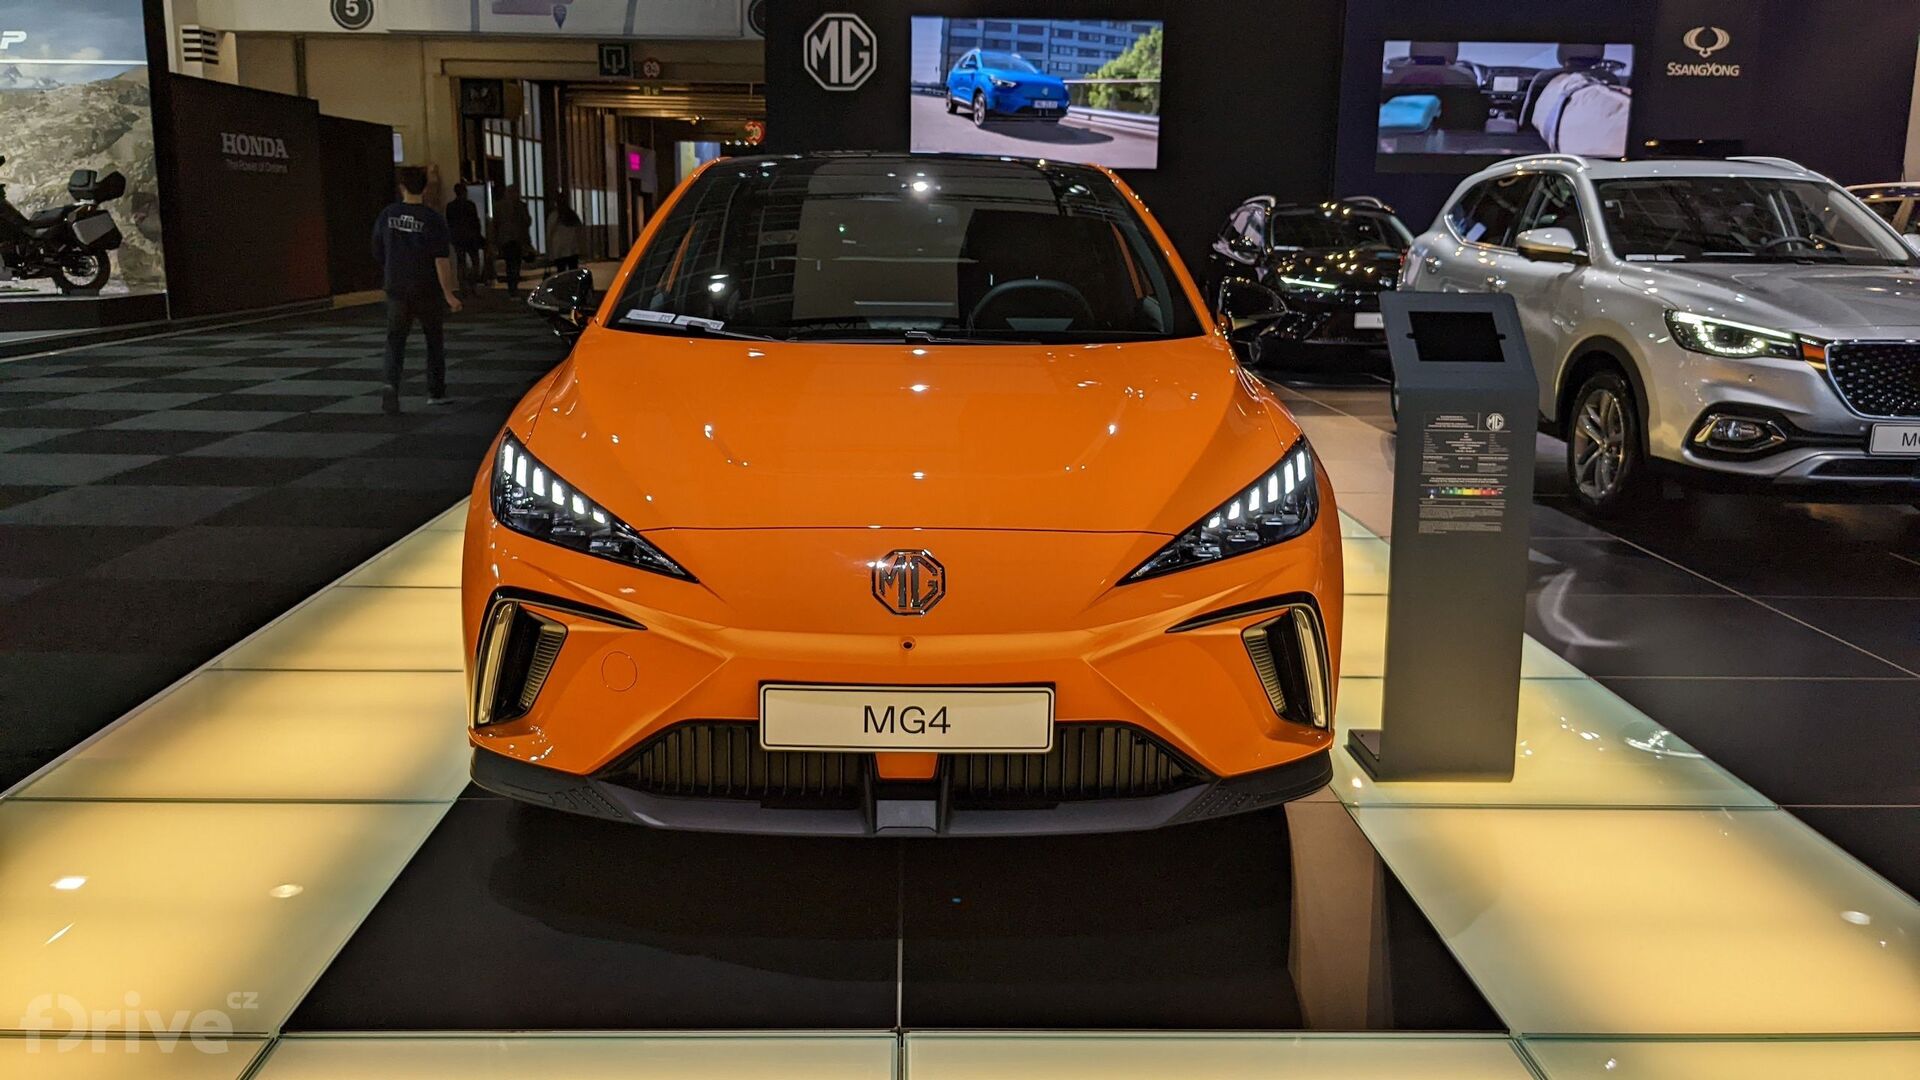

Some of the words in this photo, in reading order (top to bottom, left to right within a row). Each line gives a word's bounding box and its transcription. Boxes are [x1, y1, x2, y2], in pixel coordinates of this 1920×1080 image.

[345, 0, 360, 17] 5
[810, 20, 871, 84] MG
[221, 133, 289, 158] HONDA
[1486, 413, 1504, 431] MG
[1901, 432, 1920, 447] M
[878, 554, 939, 609] MG
[863, 704, 951, 735] MG4
